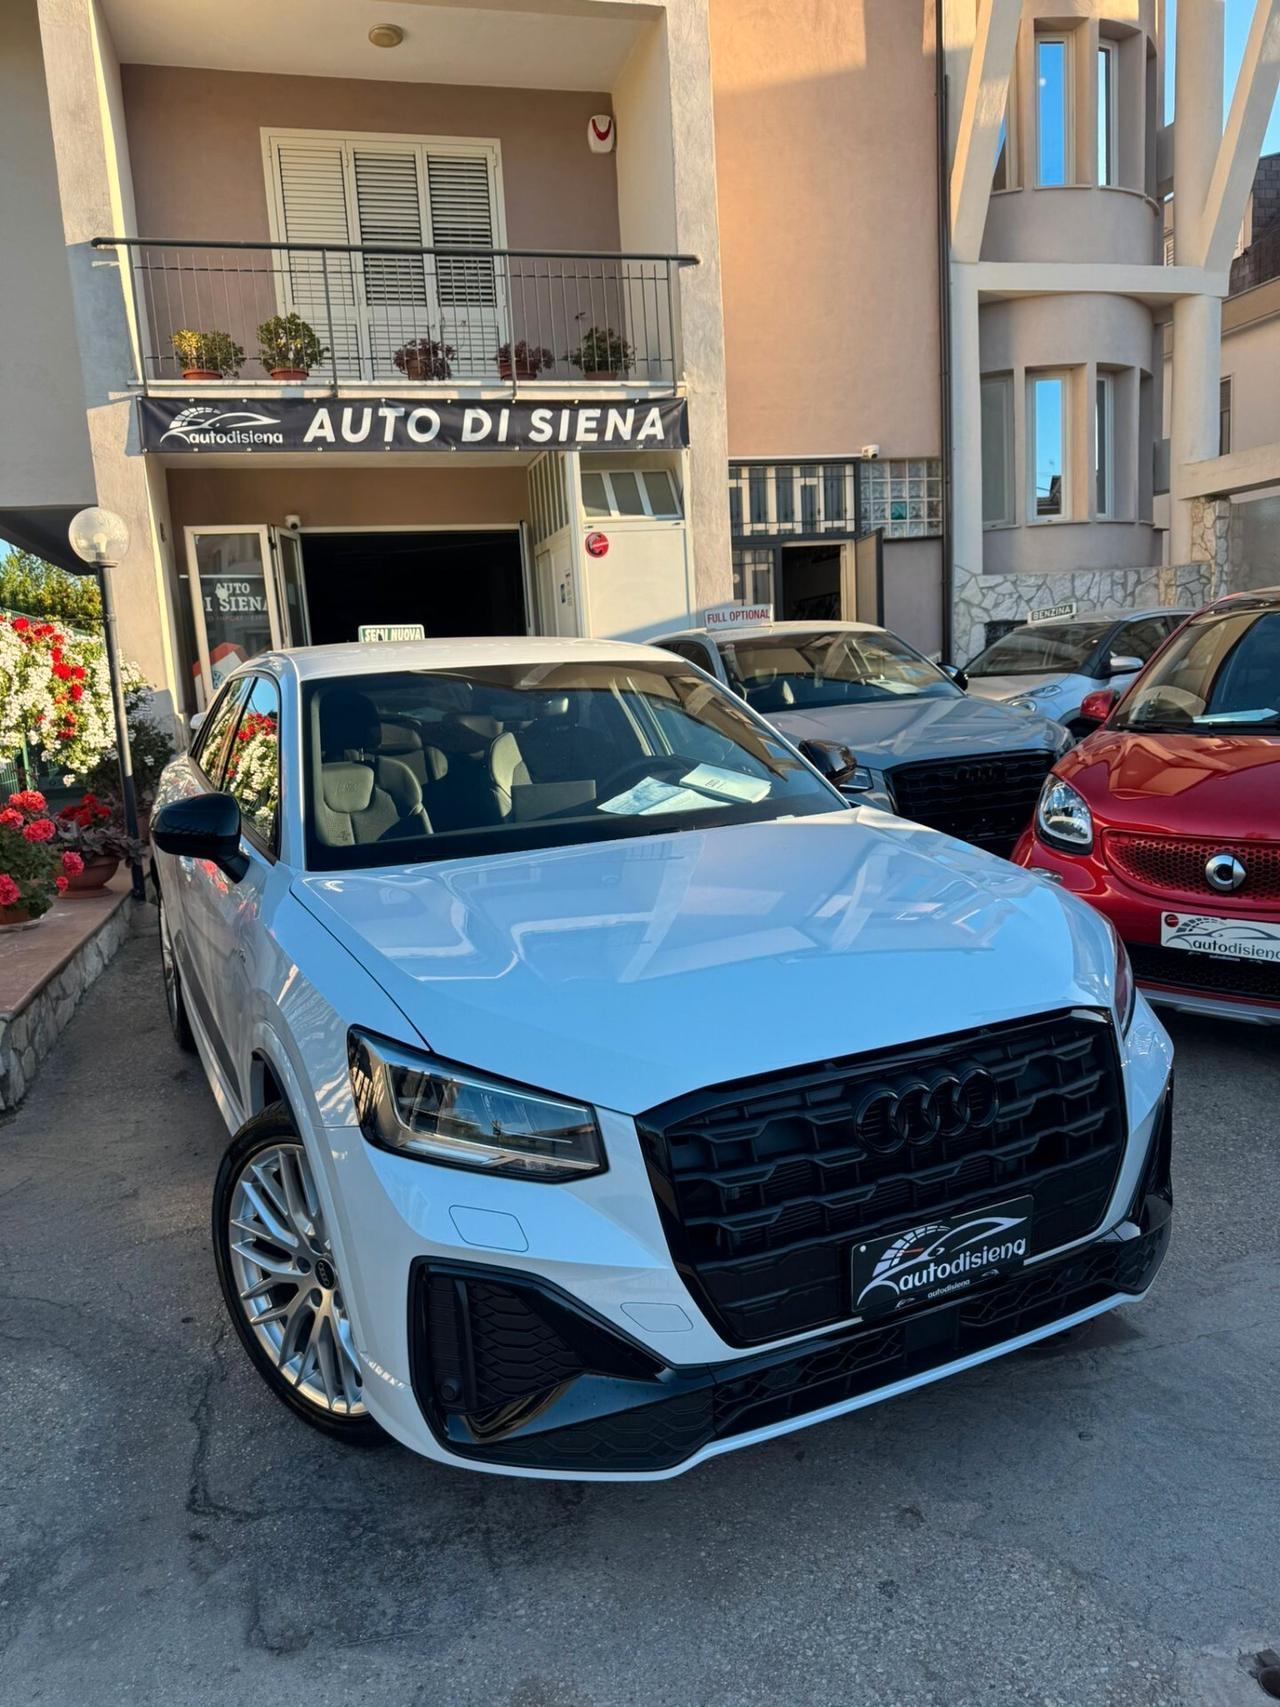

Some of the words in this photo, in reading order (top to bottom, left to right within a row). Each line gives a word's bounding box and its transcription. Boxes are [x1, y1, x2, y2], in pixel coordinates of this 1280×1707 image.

[303, 408, 441, 443] AUTO
[461, 408, 510, 443] DI
[528, 407, 665, 443] SIENA
[189, 430, 283, 444] autodisiena
[707, 613, 727, 624] FULL
[729, 608, 770, 621] OPTIONAL
[1033, 606, 1070, 619] BENZINA
[391, 627, 421, 641] NUOVA
[899, 1237, 1026, 1291] autodisiena
[927, 1279, 971, 1299] autodisiena
